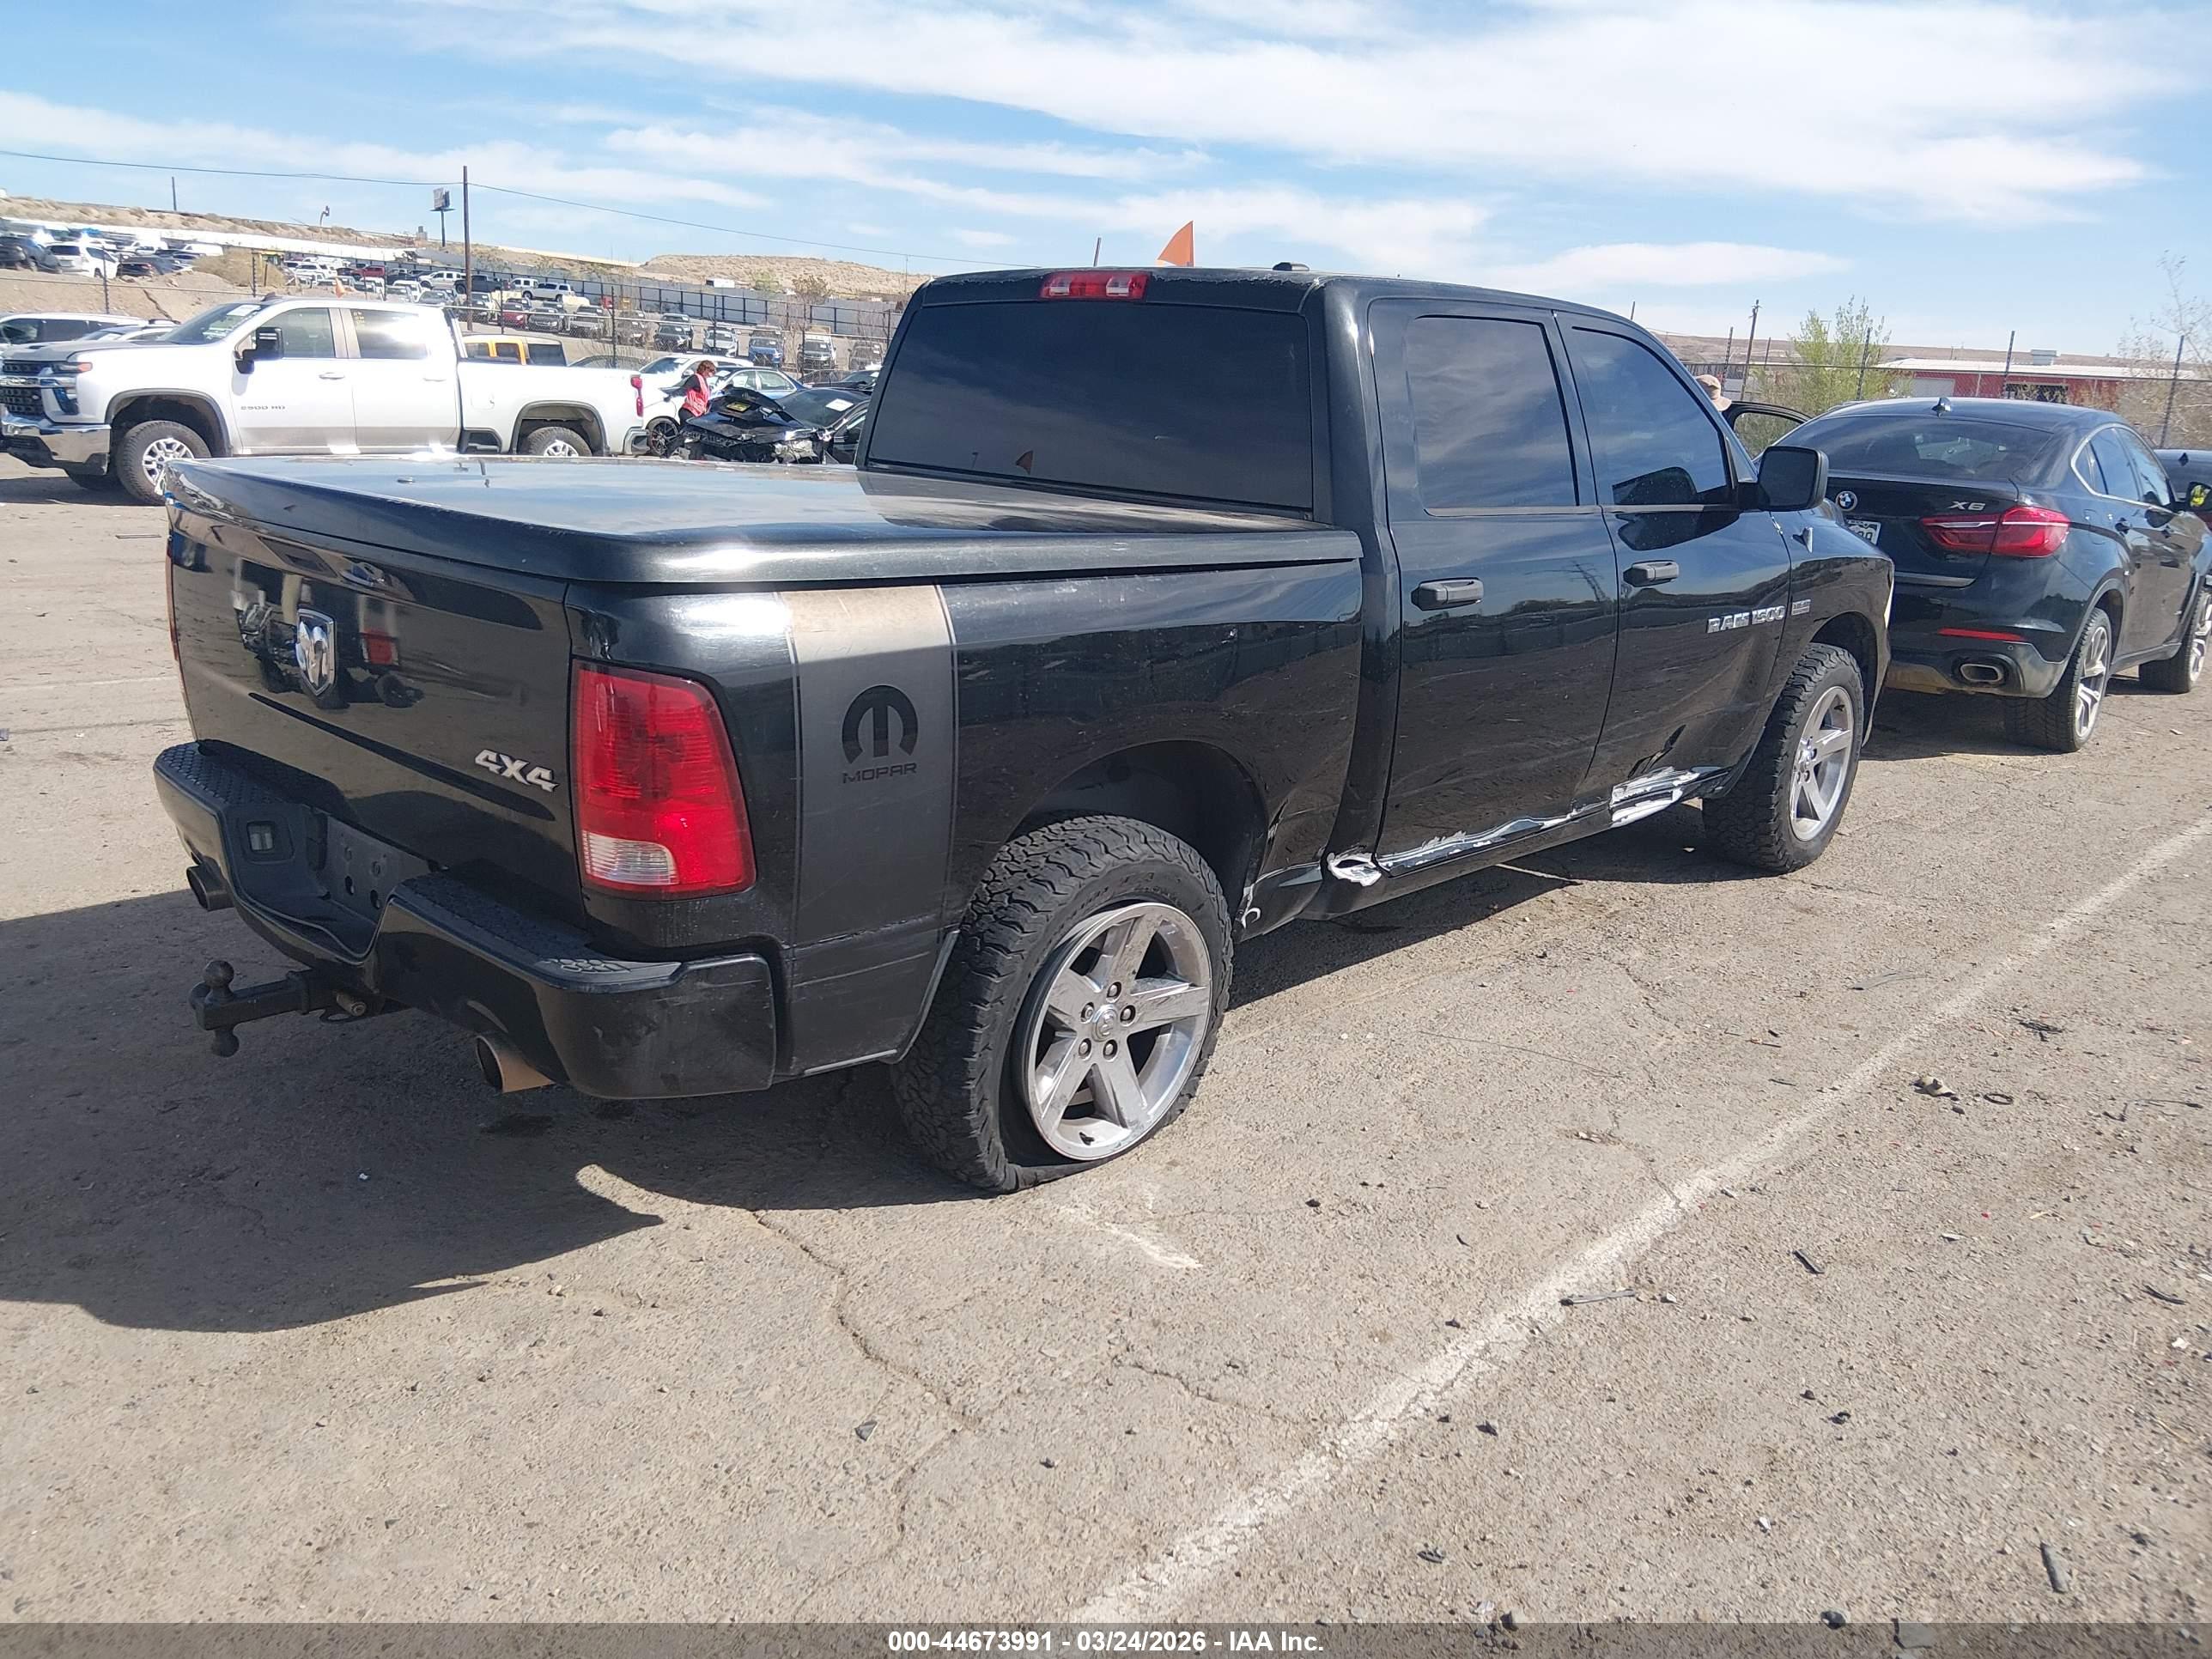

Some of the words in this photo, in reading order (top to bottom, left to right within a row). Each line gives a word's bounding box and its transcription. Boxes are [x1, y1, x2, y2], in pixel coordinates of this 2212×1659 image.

[1947, 501, 1985, 512] X6
[1707, 611, 1750, 634] RAM
[1752, 605, 1786, 625] 1500
[842, 762, 918, 784] MOPAR
